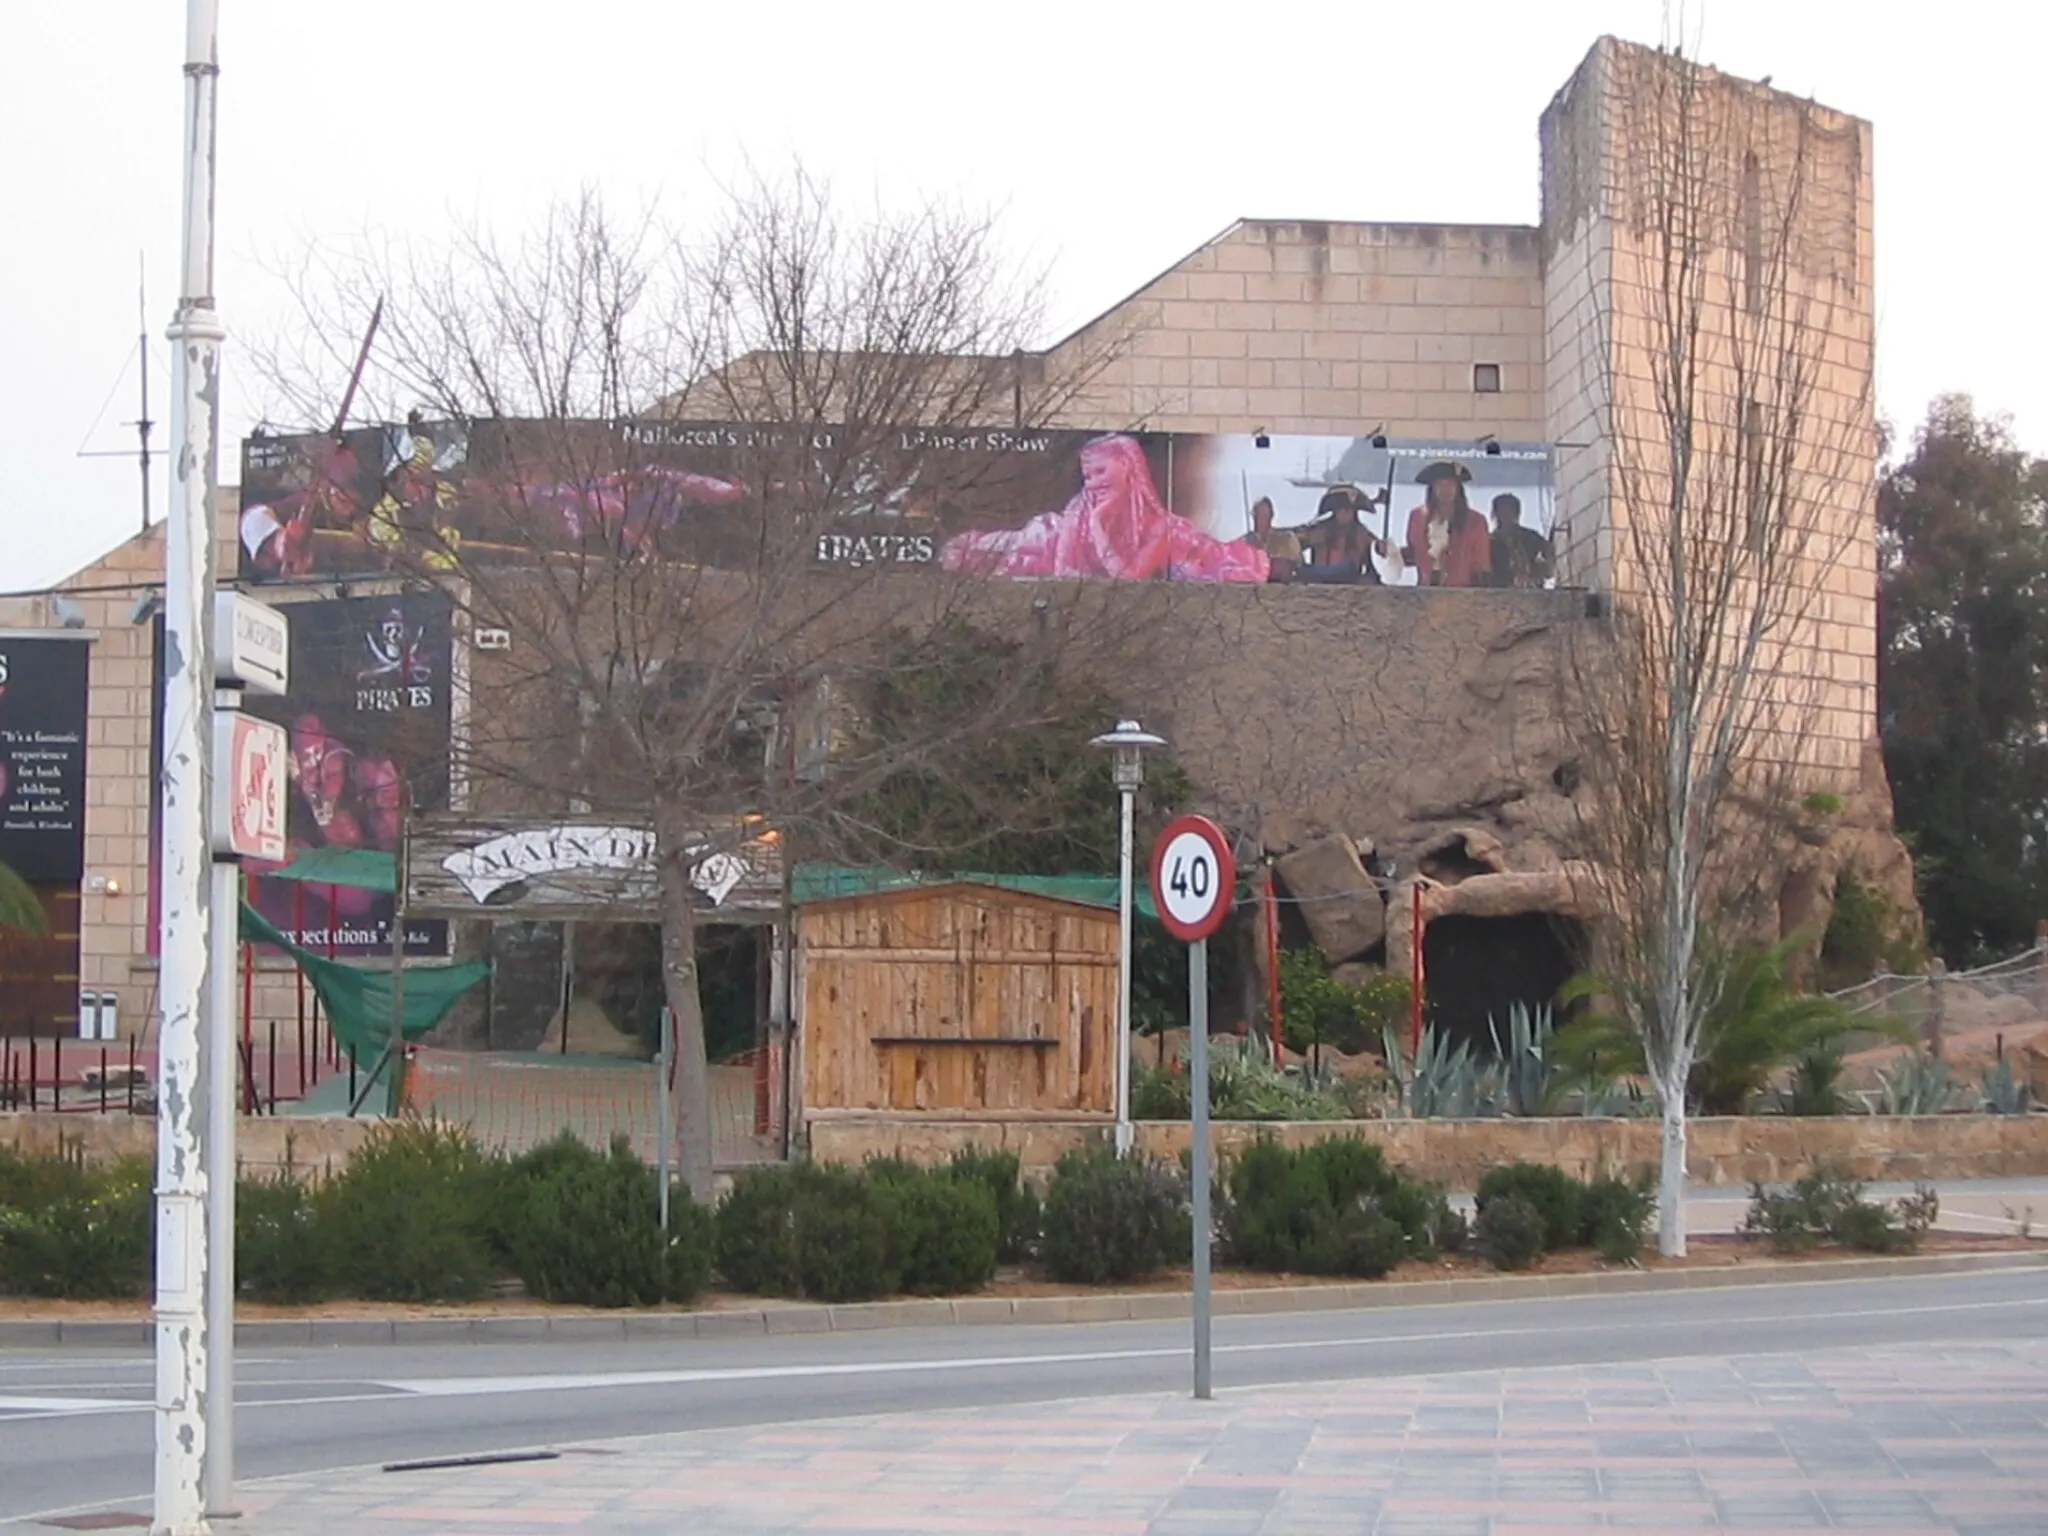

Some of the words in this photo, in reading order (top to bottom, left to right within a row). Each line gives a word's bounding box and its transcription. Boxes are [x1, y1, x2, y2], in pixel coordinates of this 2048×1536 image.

[986, 432, 1049, 451] Show
[817, 535, 933, 567] IRATES
[1171, 856, 1209, 898] 40
